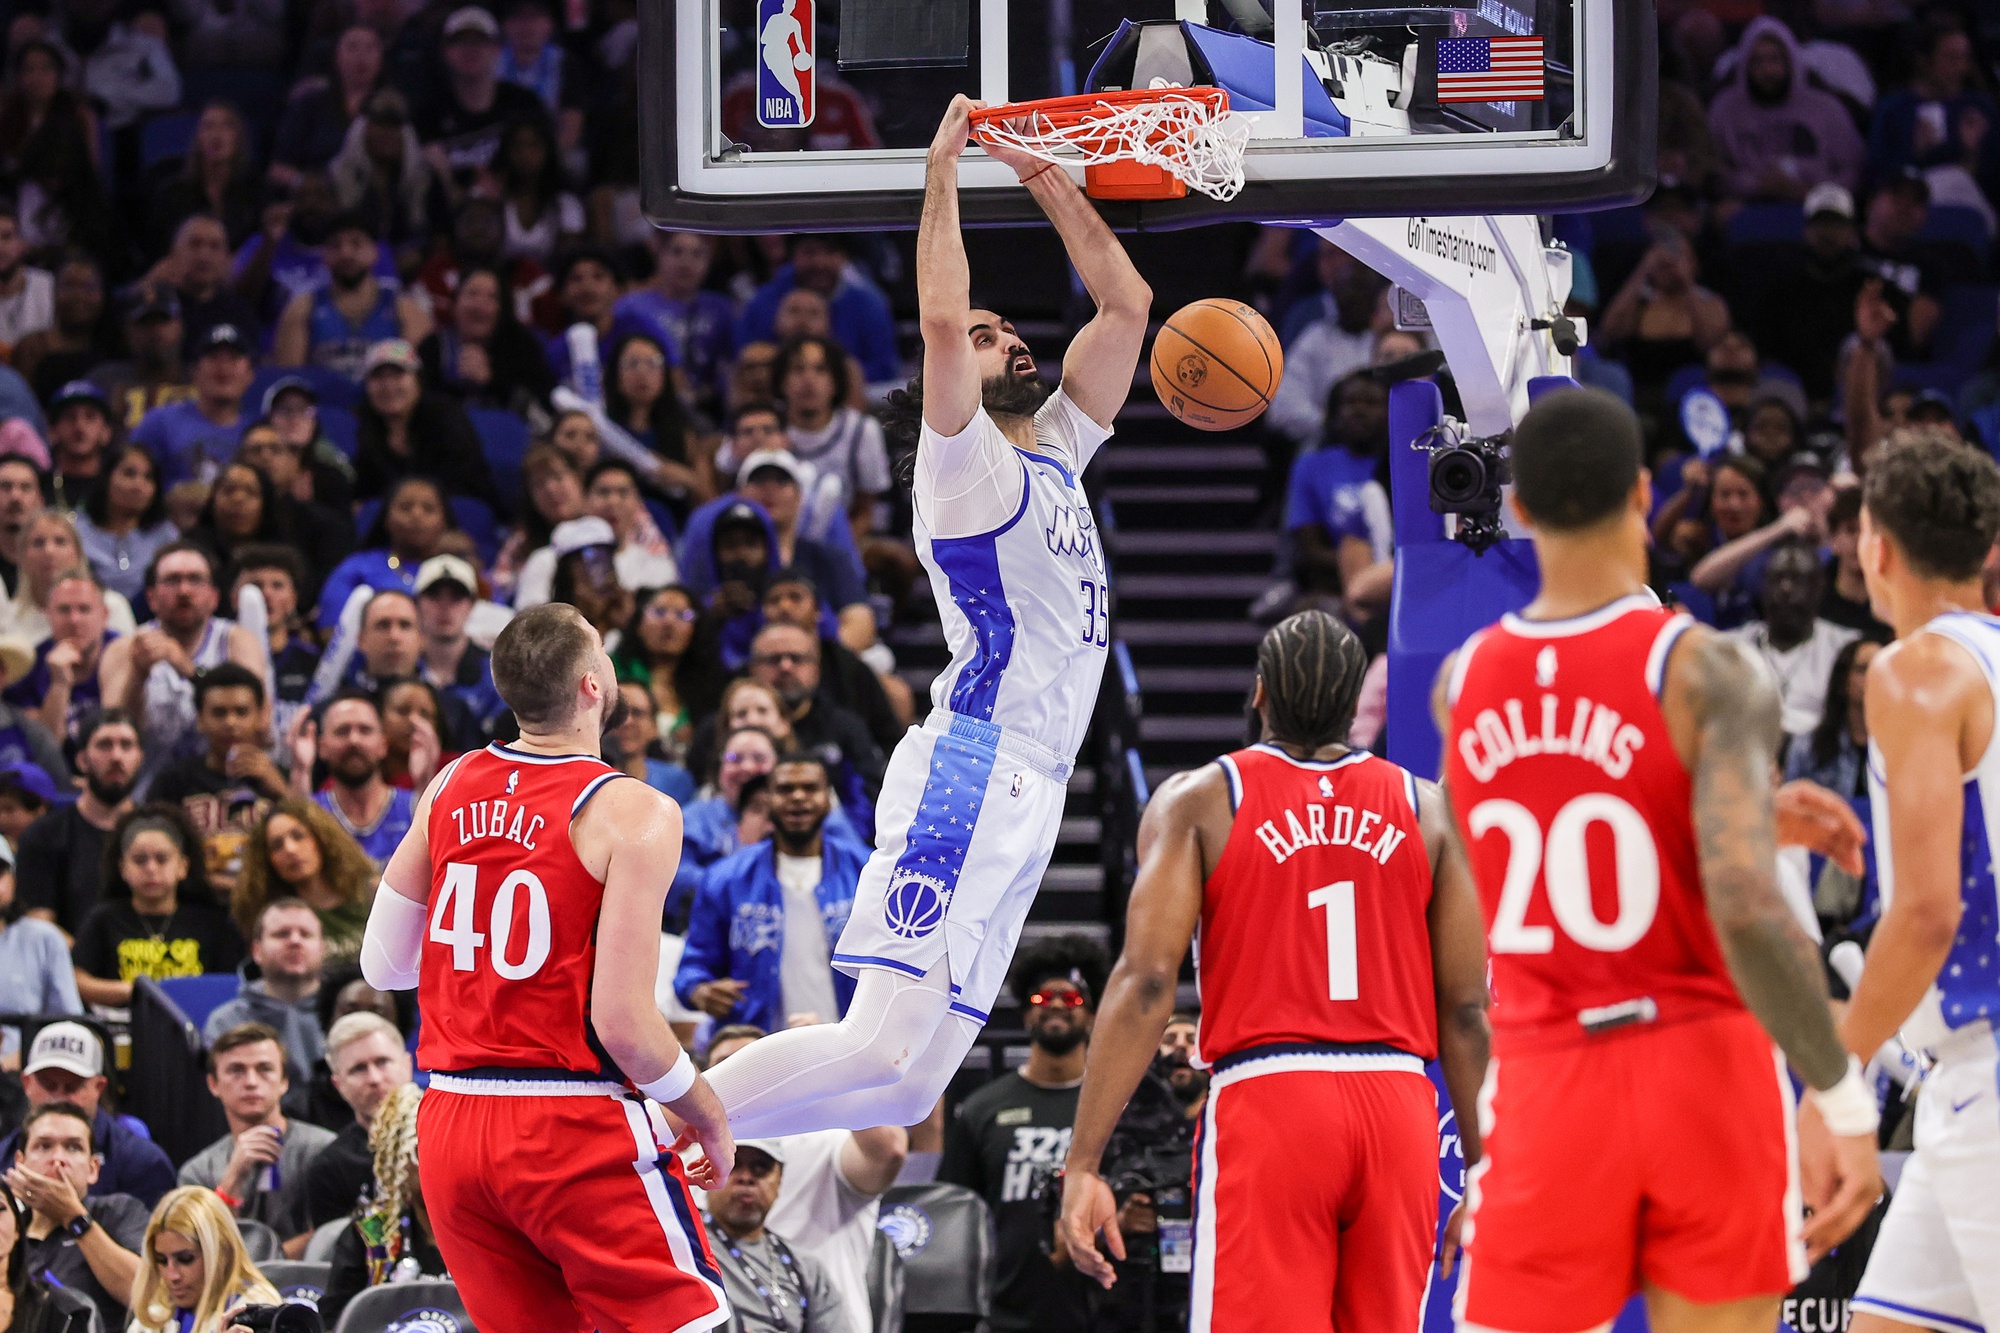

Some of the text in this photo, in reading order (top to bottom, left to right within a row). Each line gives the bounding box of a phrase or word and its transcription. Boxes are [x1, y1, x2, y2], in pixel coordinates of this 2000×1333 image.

[765, 97, 793, 119] NBA
[1407, 216, 1496, 278] GoTimesharing.com
[1079, 577, 1109, 650] 35
[1458, 693, 1645, 784] COLLINS
[451, 800, 545, 851] ZUBAC
[1255, 803, 1406, 865] HARDEN
[1467, 791, 1661, 955] 20
[429, 861, 551, 981] 40
[1307, 880, 1359, 1001] 1
